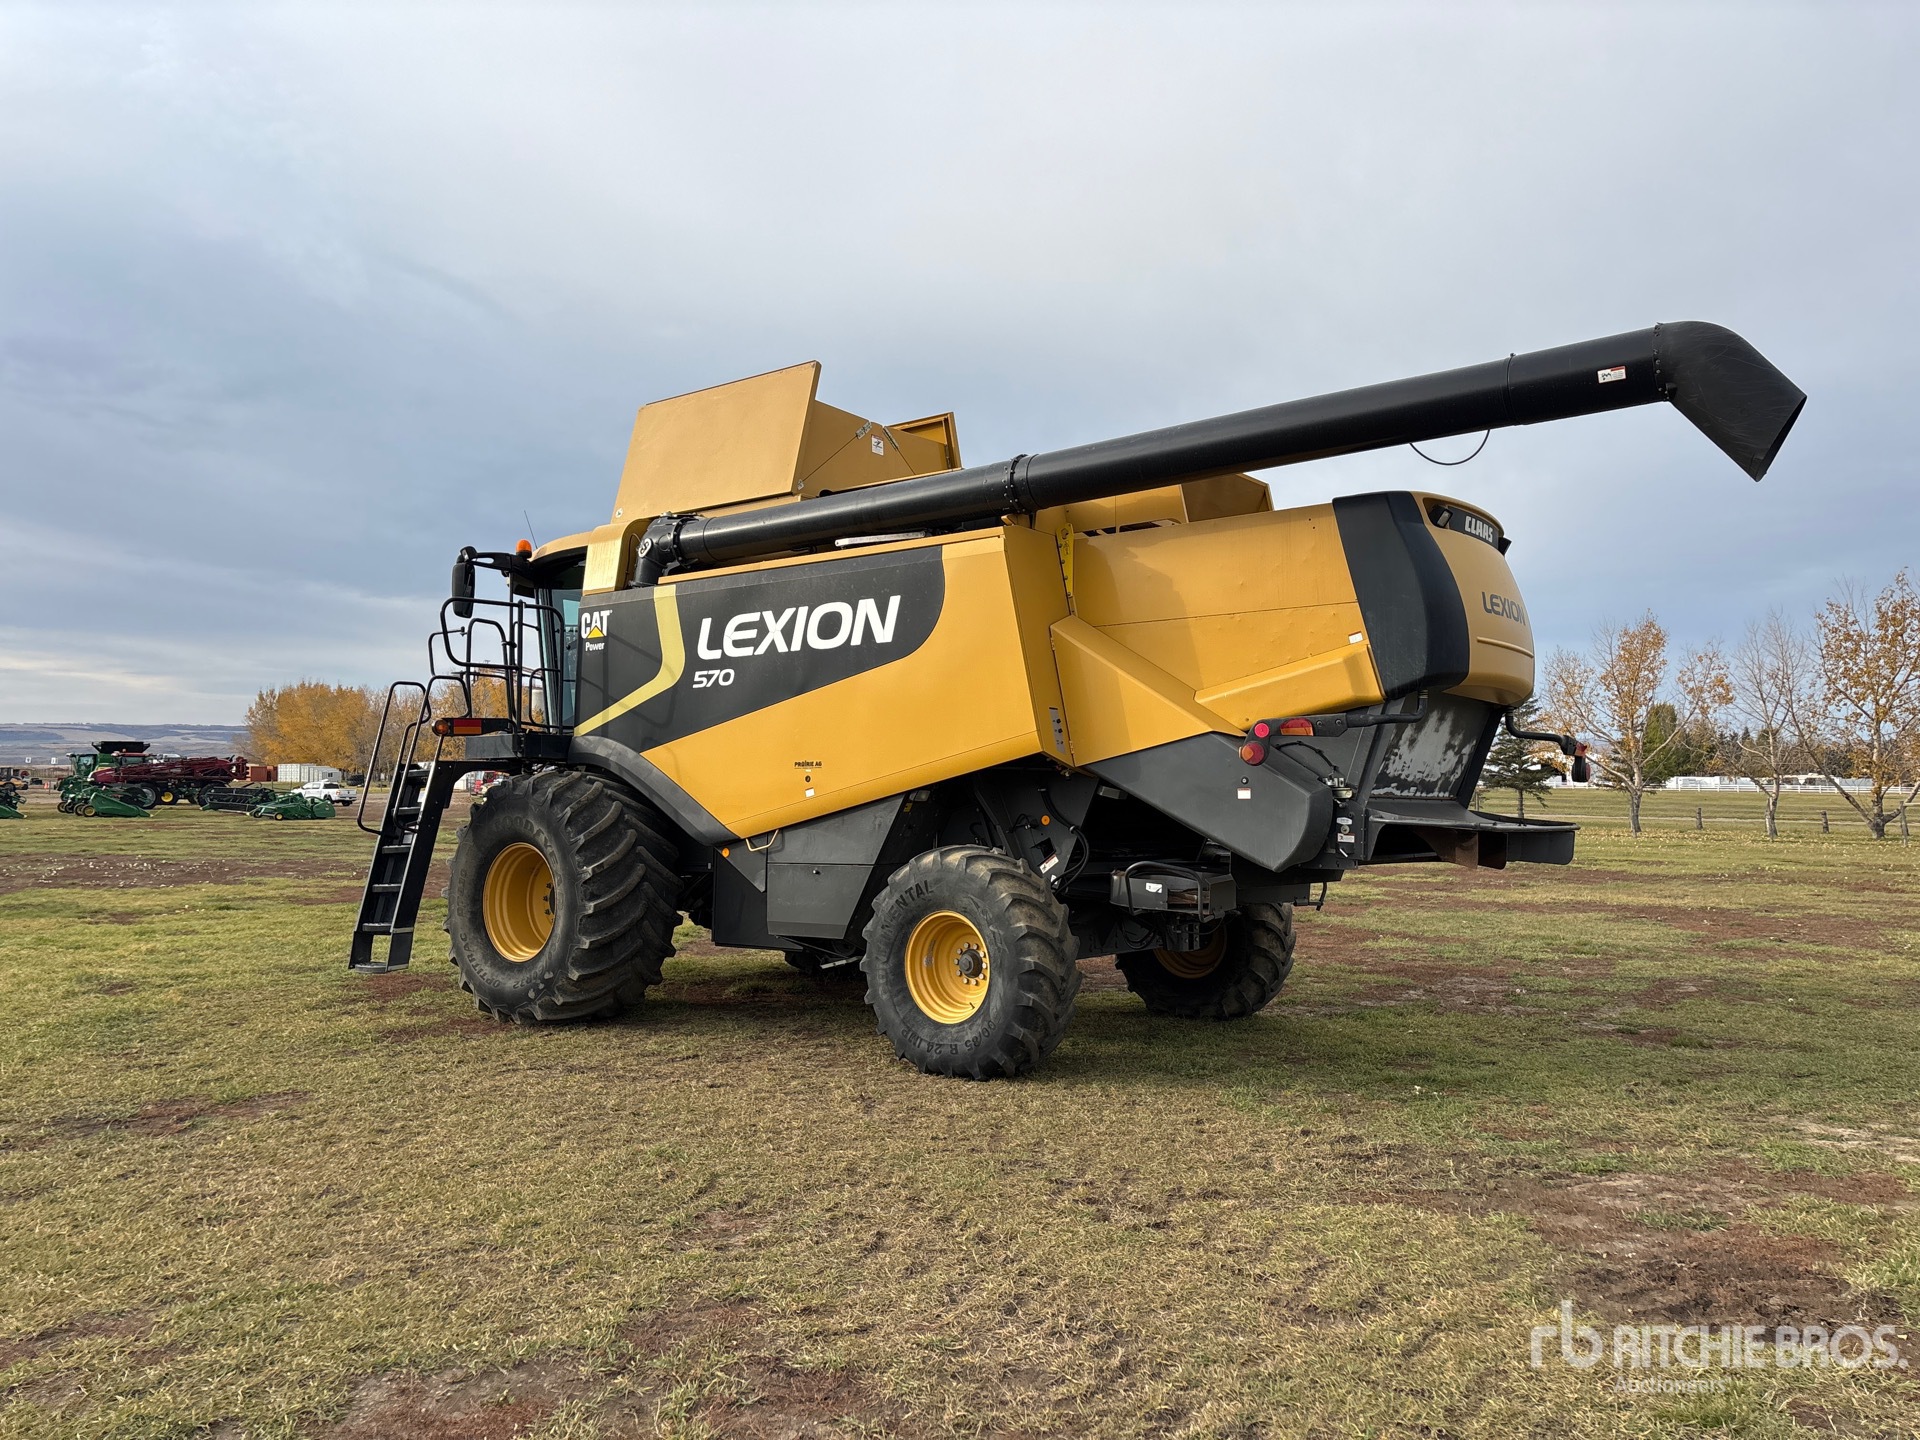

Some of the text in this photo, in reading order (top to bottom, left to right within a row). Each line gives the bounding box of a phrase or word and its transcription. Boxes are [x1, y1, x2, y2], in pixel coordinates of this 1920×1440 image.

[1464, 515, 1494, 543] CLAAS
[1481, 591, 1527, 627] LEXION
[581, 610, 610, 639] CAT
[697, 595, 901, 660] LEXION
[585, 641, 605, 652] Power
[692, 668, 735, 688] 570
[460, 932, 500, 988] OPTITRAC
